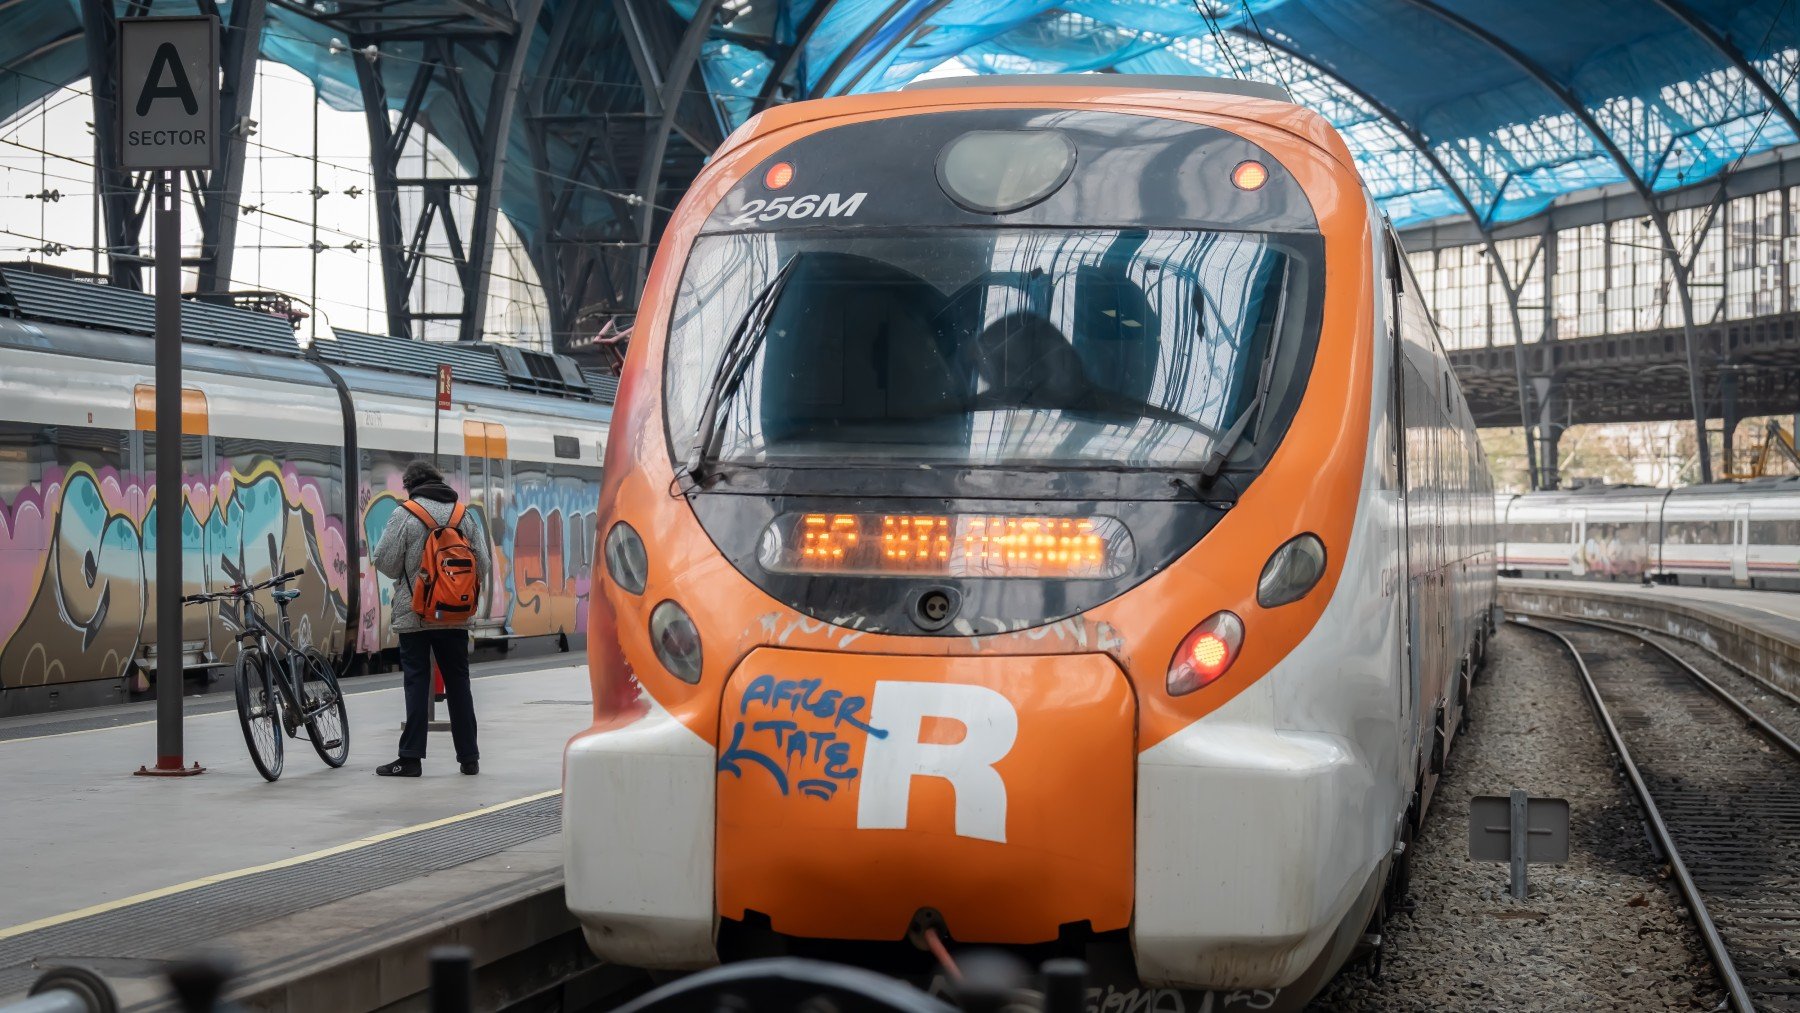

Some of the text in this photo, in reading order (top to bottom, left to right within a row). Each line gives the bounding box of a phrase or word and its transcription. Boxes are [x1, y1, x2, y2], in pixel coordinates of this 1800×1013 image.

[136, 42, 198, 116] A
[128, 130, 206, 146] SECTOR
[729, 192, 868, 226] 256M
[857, 680, 1018, 843] R
